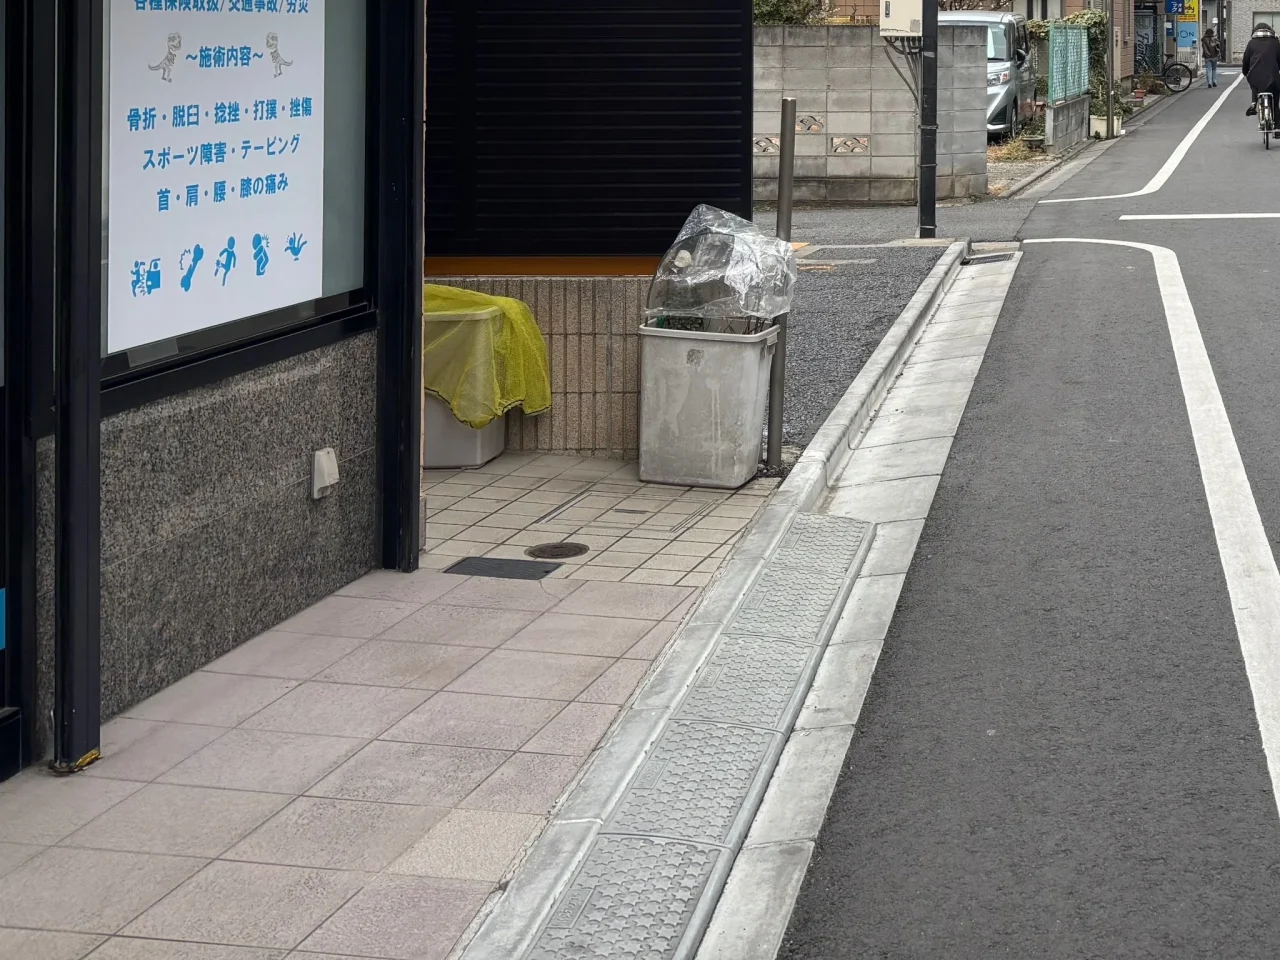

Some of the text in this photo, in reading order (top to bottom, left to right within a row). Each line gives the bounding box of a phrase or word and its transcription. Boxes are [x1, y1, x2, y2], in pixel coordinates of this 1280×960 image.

[127, 96, 313, 132] 骨折・脱臼・捻挫・打撲・挫傷
[142, 133, 301, 171] スポーツ障害・テーピング
[156, 172, 289, 213] 首・肩・腰・膝の痛み
